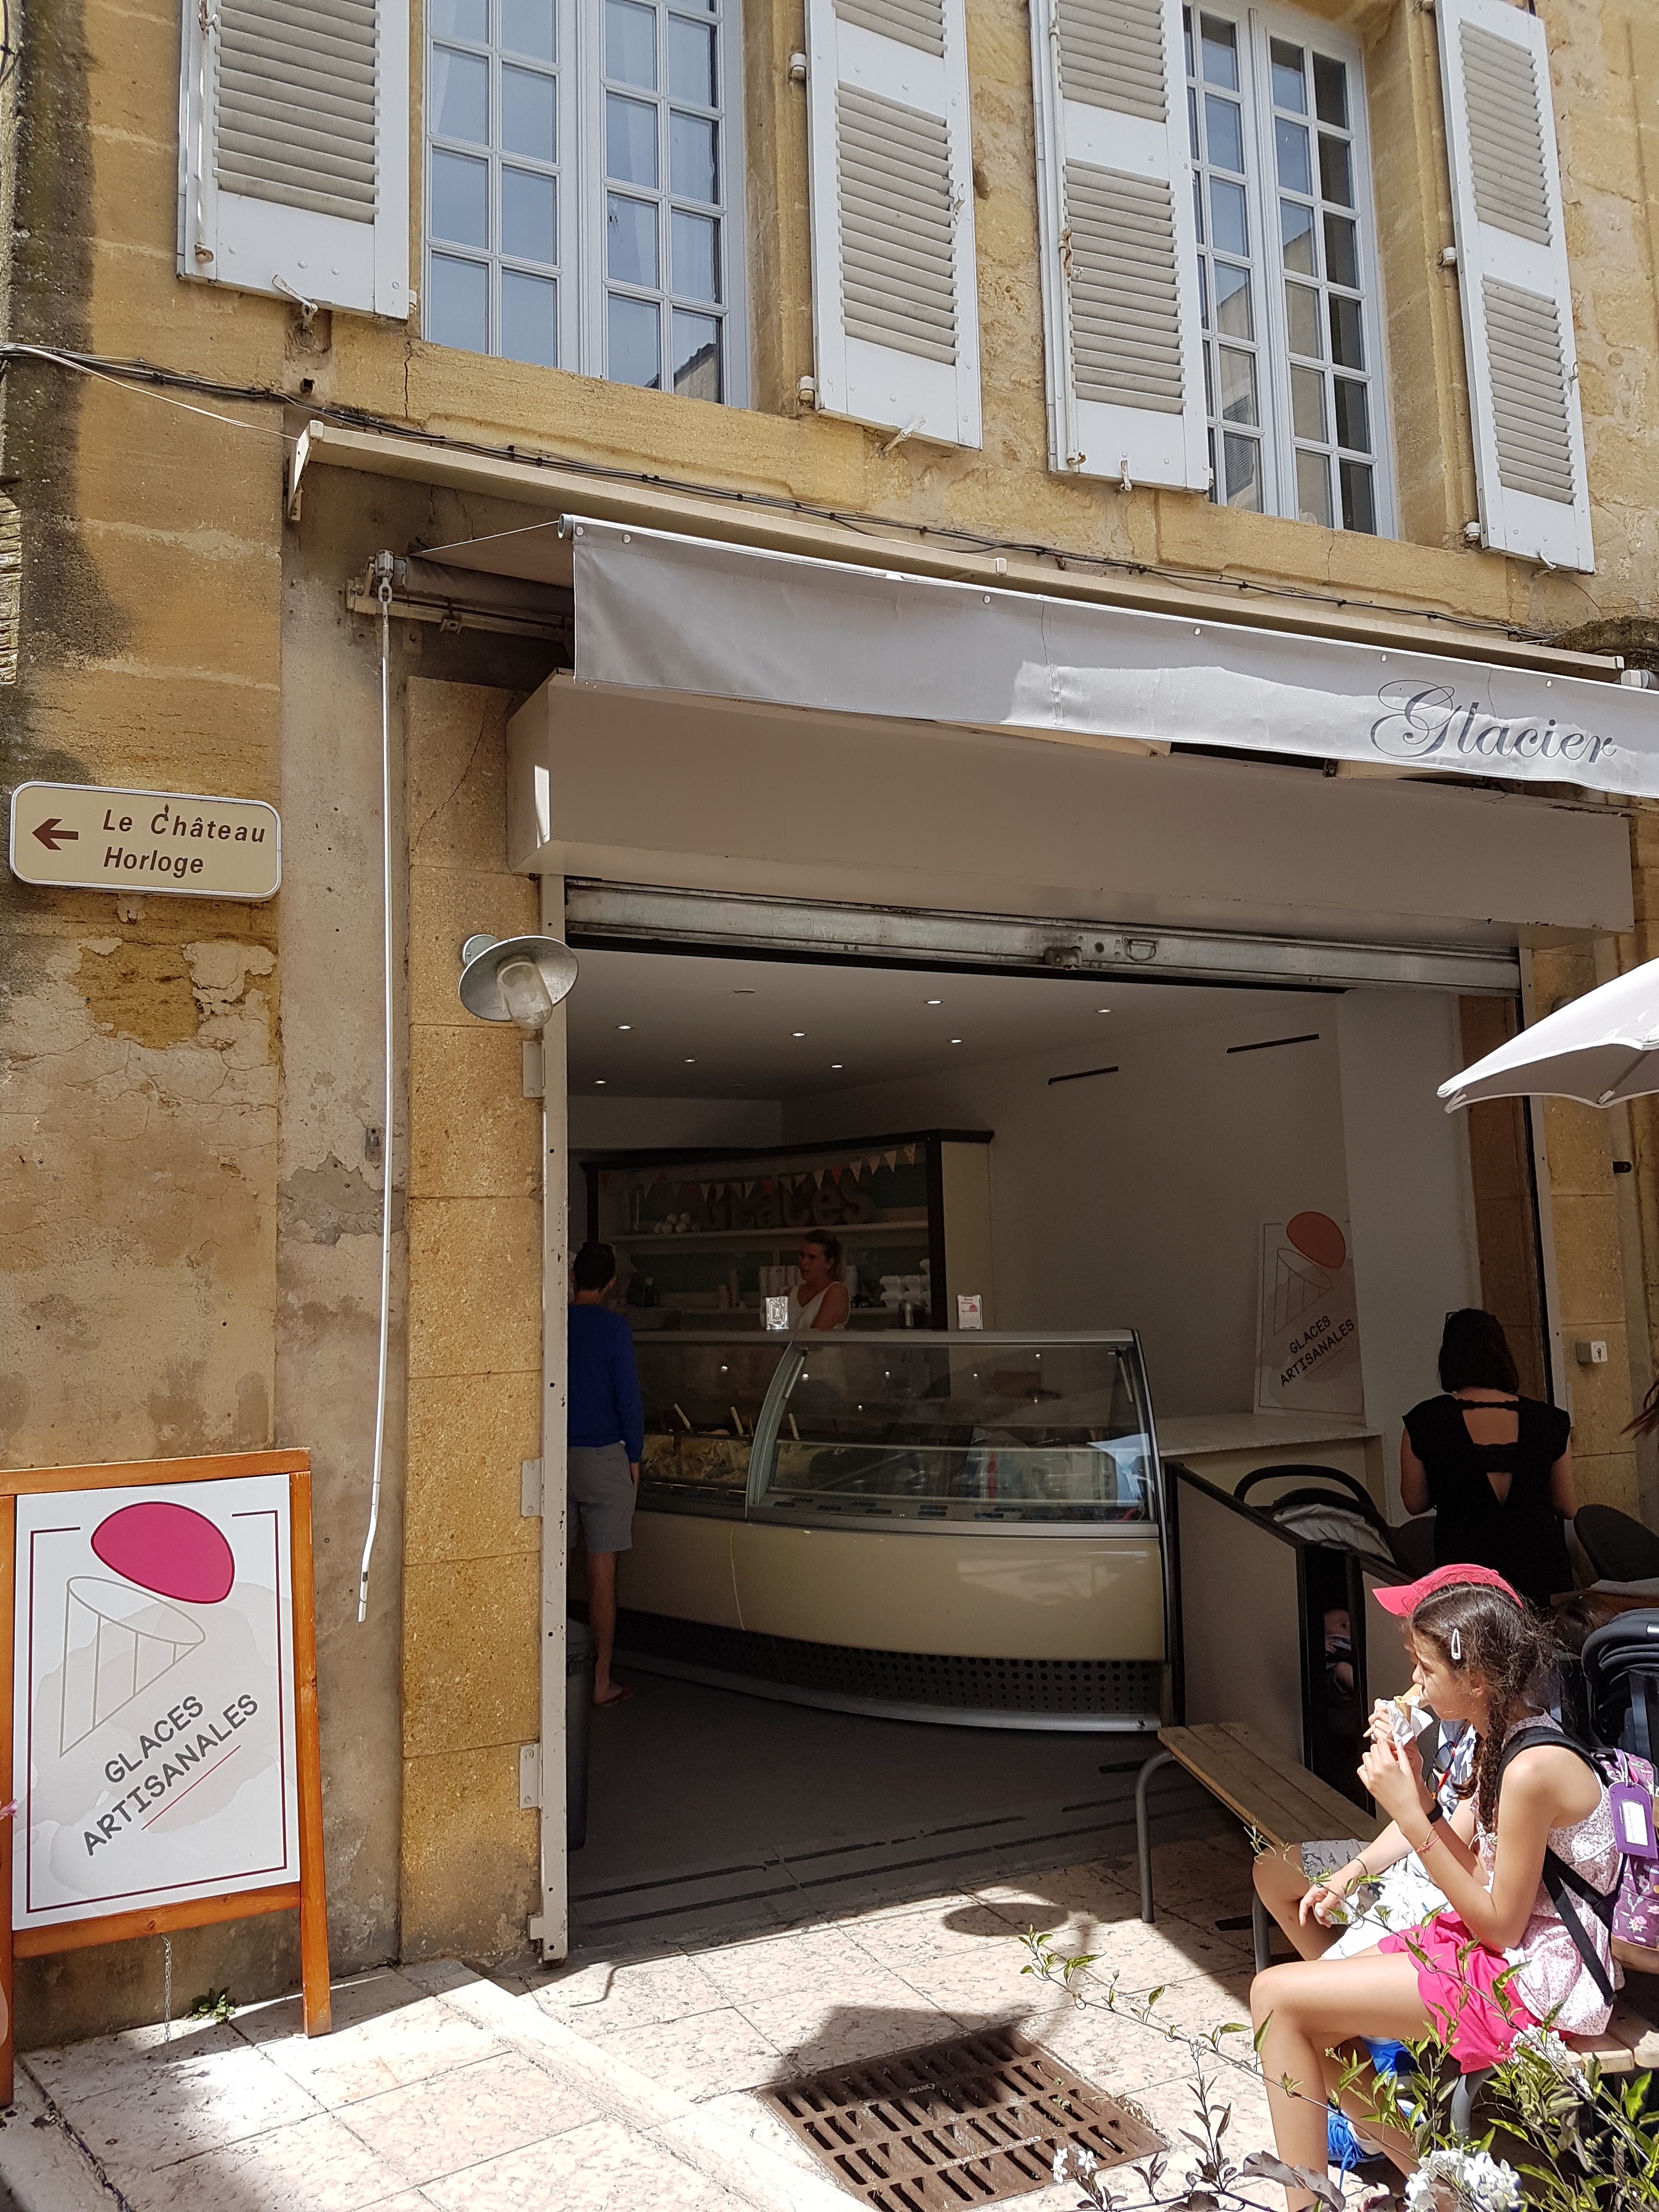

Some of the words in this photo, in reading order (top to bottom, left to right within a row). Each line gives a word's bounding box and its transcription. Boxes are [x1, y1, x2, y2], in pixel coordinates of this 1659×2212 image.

[1370, 679, 1617, 763] Glacier
[103, 809, 133, 832] Le
[150, 813, 266, 843] Château
[103, 846, 204, 878] Horloge
[1280, 1318, 1355, 1387] ARTISANALES
[1289, 1315, 1331, 1354] GLACES
[105, 1695, 204, 1782] GLACES
[83, 1694, 258, 1856] ARTISANALES
